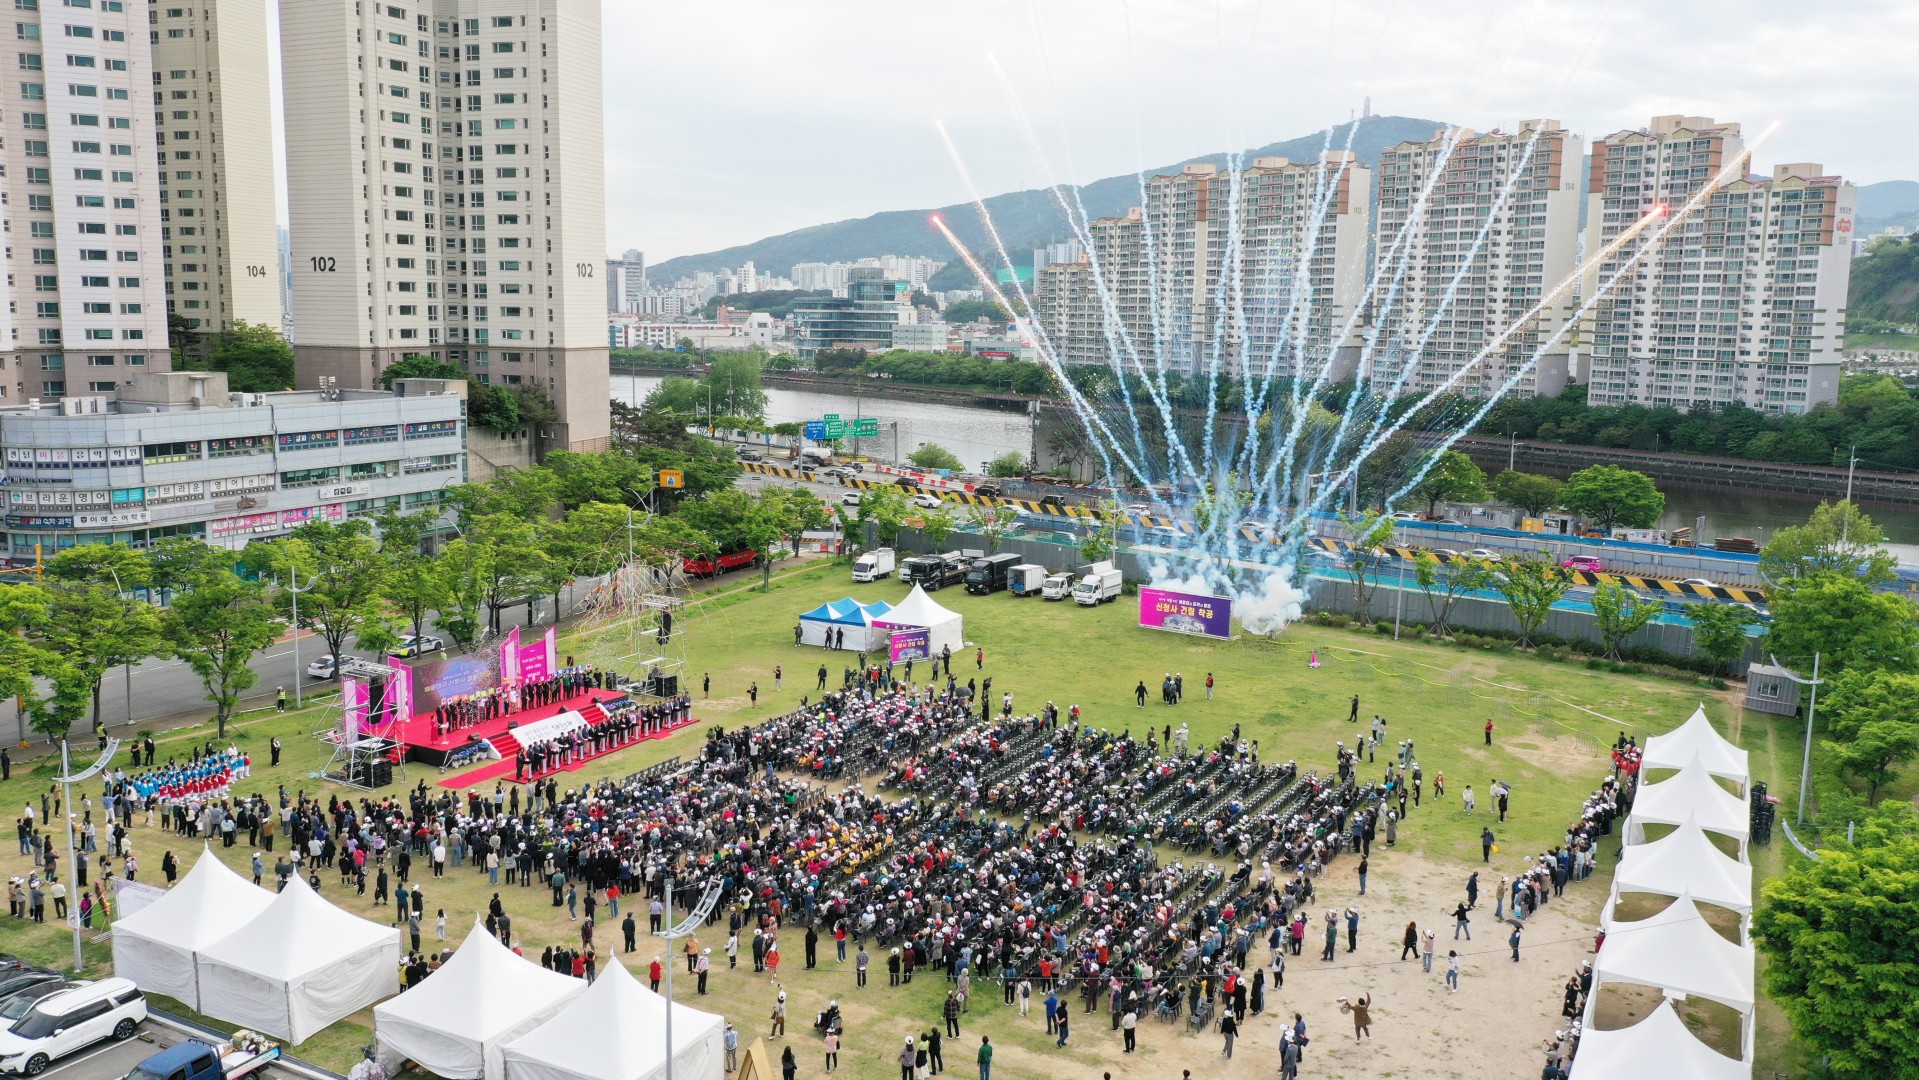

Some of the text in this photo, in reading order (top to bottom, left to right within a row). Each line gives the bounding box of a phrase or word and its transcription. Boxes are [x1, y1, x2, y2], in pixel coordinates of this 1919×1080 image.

[246, 265, 266, 277] 104
[310, 257, 336, 272] 102
[576, 263, 593, 278] 102
[164, 483, 200, 495] 브라운
[26, 493, 68, 503] 브라운
[78, 492, 105, 503] 영어
[1156, 602, 1178, 614] 신청사
[1180, 605, 1195, 616] 건립
[1198, 608, 1214, 619] 착공
